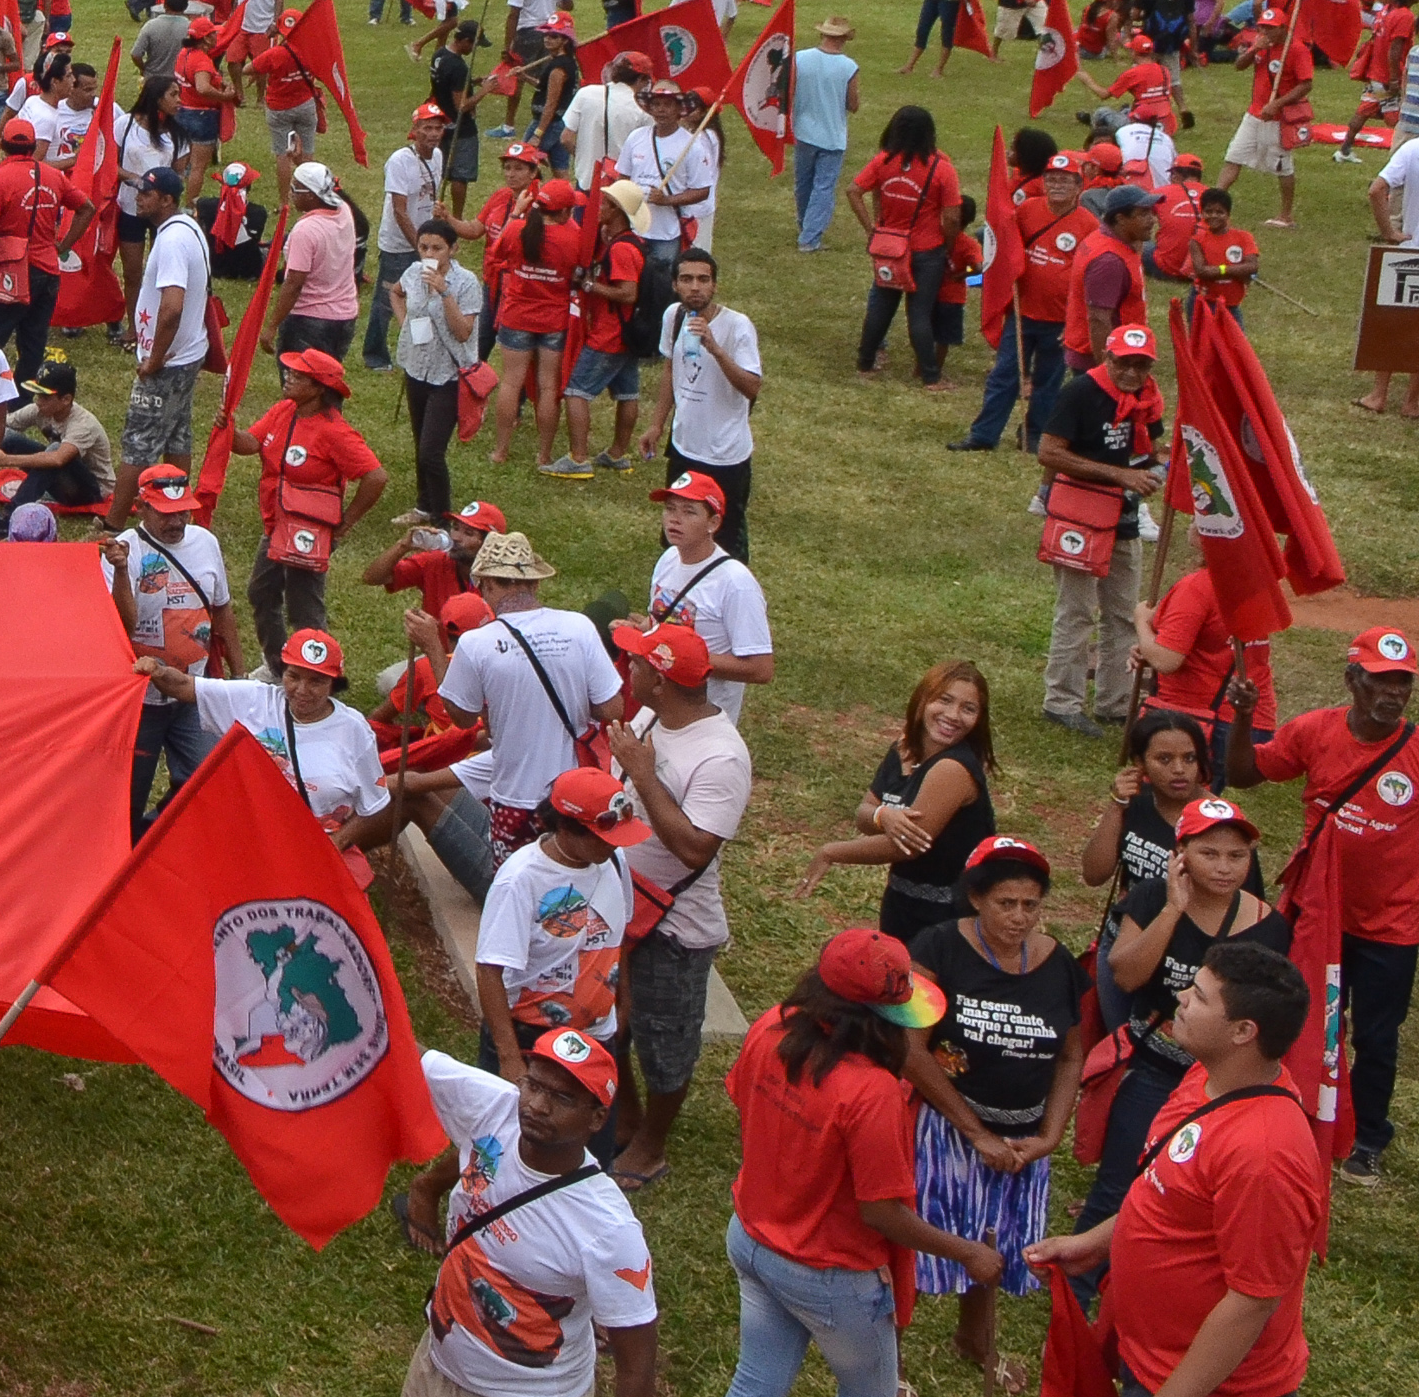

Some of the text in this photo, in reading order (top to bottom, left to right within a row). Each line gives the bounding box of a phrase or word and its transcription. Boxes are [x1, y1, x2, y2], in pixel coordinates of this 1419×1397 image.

[167, 595, 185, 605] MST
[247, 908, 279, 921] DOS
[1165, 956, 1188, 973] Faz
[956, 994, 1021, 1014] Faz escuro
[956, 1013, 1057, 1038] porque a manhã
[963, 1007, 1044, 1026] mas eu canto
[964, 1028, 1035, 1049] vai chegar!
